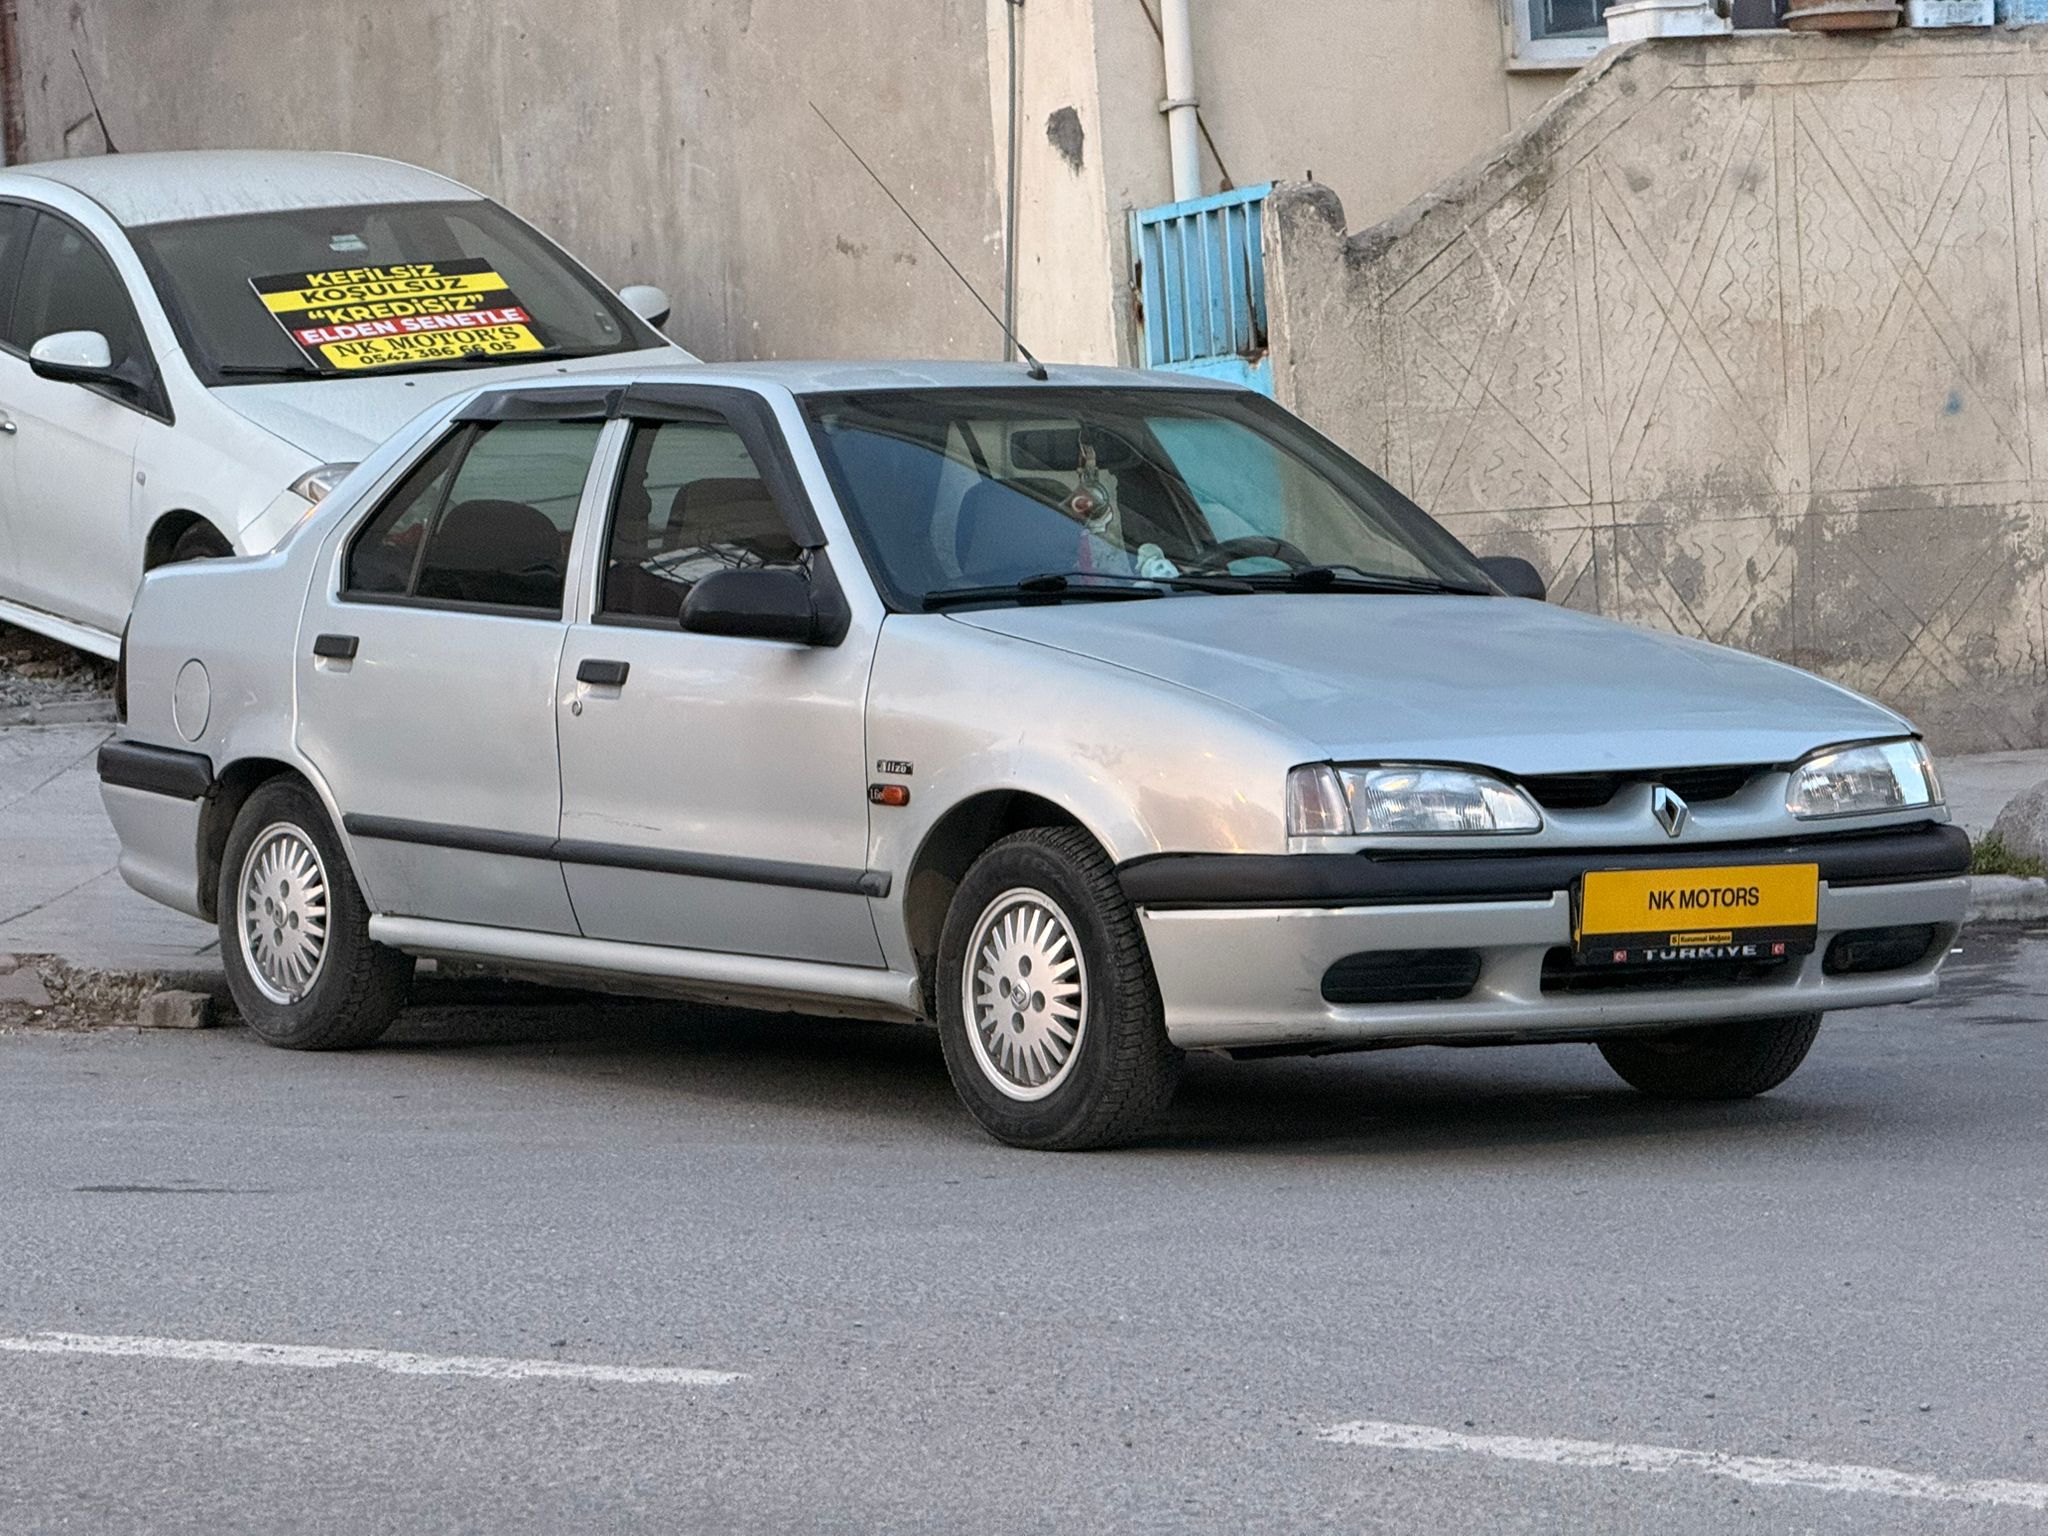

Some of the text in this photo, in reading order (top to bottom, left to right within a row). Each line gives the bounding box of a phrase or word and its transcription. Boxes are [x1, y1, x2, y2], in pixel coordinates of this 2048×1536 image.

[306, 264, 441, 287] KEFİLSİZ
[301, 278, 468, 303] KOŞULSUZ
[301, 310, 522, 344] ELDEN SENETLE
[333, 326, 521, 357] NK MOTOR'S
[359, 350, 413, 365] 0542
[415, 346, 455, 358] 386
[490, 341, 516, 352] 05
[1648, 887, 1759, 910] NK MOTORS
